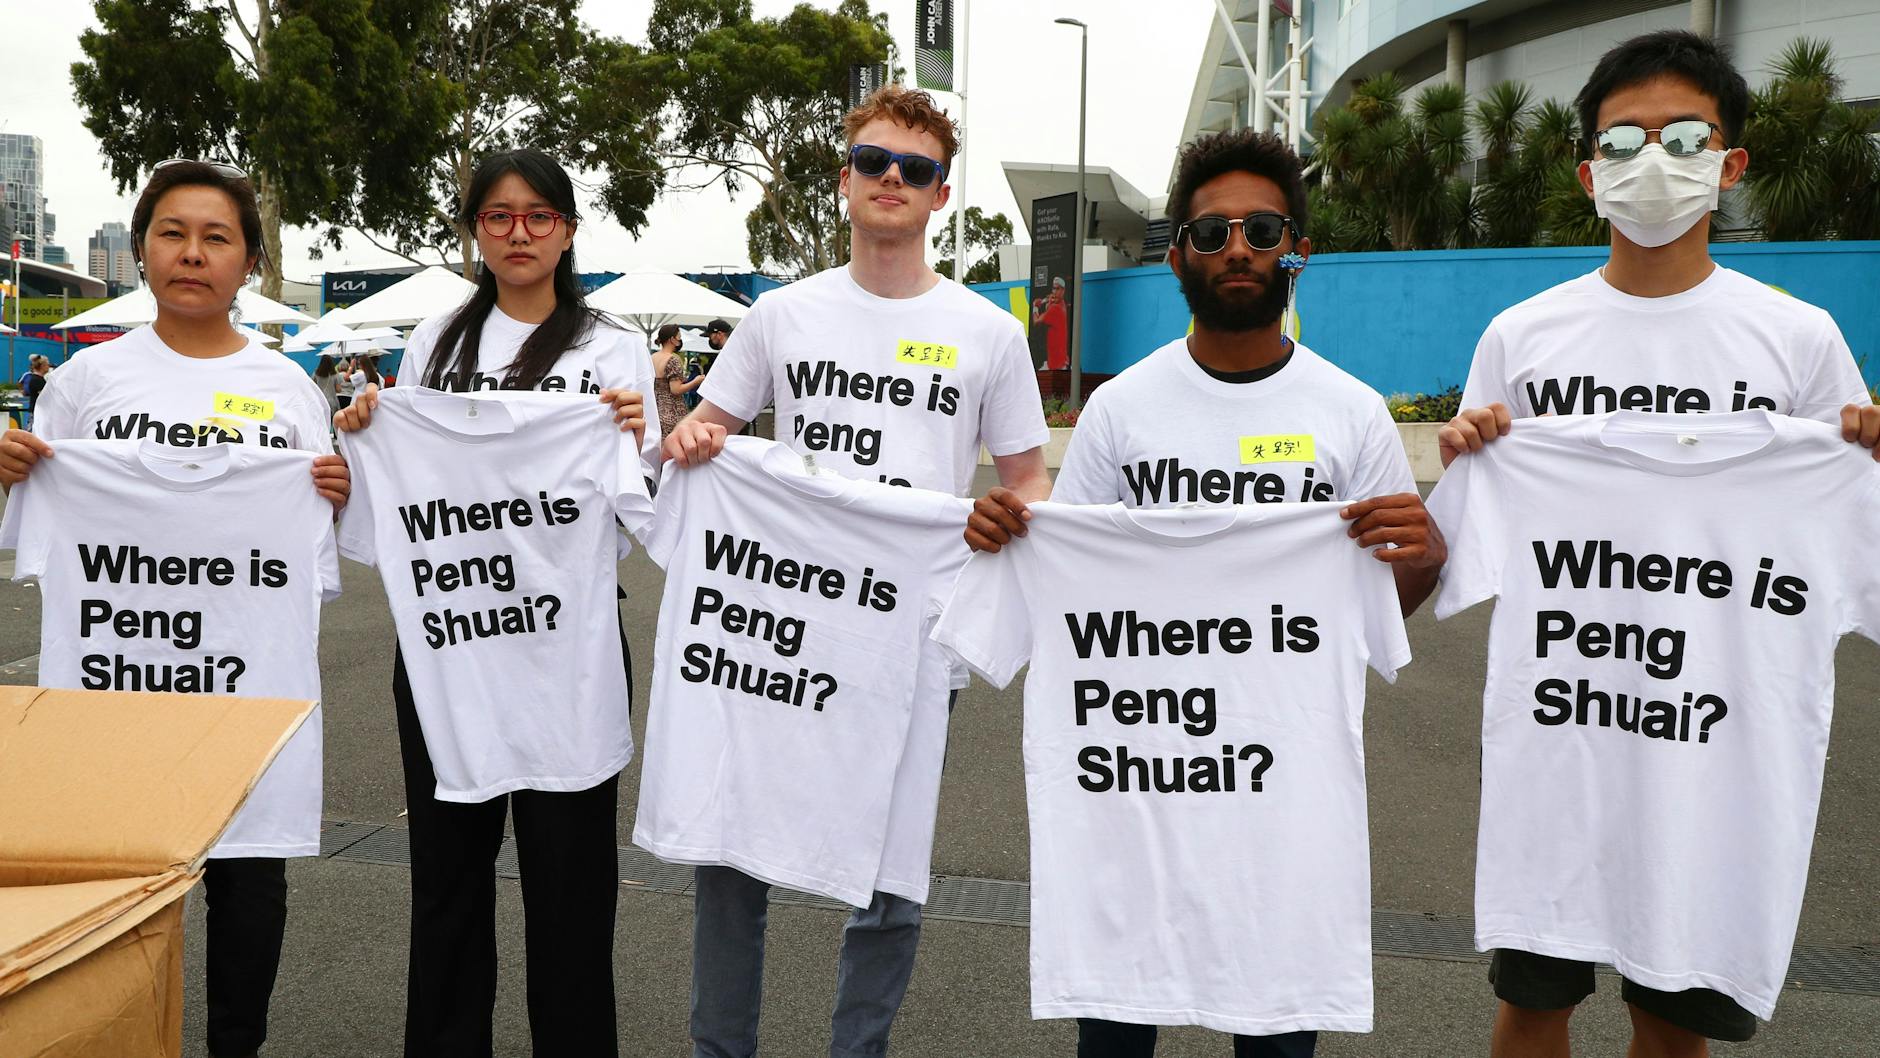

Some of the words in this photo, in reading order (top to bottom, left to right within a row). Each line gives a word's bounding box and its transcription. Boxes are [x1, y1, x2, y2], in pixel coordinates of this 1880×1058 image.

[927, 0, 936, 15] CA
[927, 16, 936, 45] JOHN
[934, 0, 942, 26] AREN
[31, 306, 52, 318] good
[438, 371, 566, 393] Whe
[786, 361, 914, 407] Where
[927, 373, 960, 416] is
[1526, 375, 1711, 417] Where
[94, 413, 244, 448] Where
[1121, 458, 1285, 506] Where
[1300, 467, 1334, 503] is
[399, 499, 534, 542] Where
[540, 490, 581, 526] is
[77, 544, 235, 586] Where
[249, 549, 288, 588] is
[410, 555, 516, 597] Peng
[705, 530, 846, 600] Where
[857, 567, 898, 613] is
[1532, 541, 1733, 599] Where
[1750, 558, 1809, 616] is
[80, 600, 202, 649] Peng
[423, 594, 562, 650] Shuai?
[690, 587, 806, 658] Peng
[1065, 611, 1253, 659] Where
[1271, 604, 1320, 654] is
[1536, 611, 1686, 680] Peng
[80, 654, 246, 693] Shuai?
[680, 643, 838, 712] Shuai?
[1073, 680, 1217, 737] Peng
[1532, 679, 1728, 744] Shuai?
[1077, 744, 1274, 793] Shuai?
